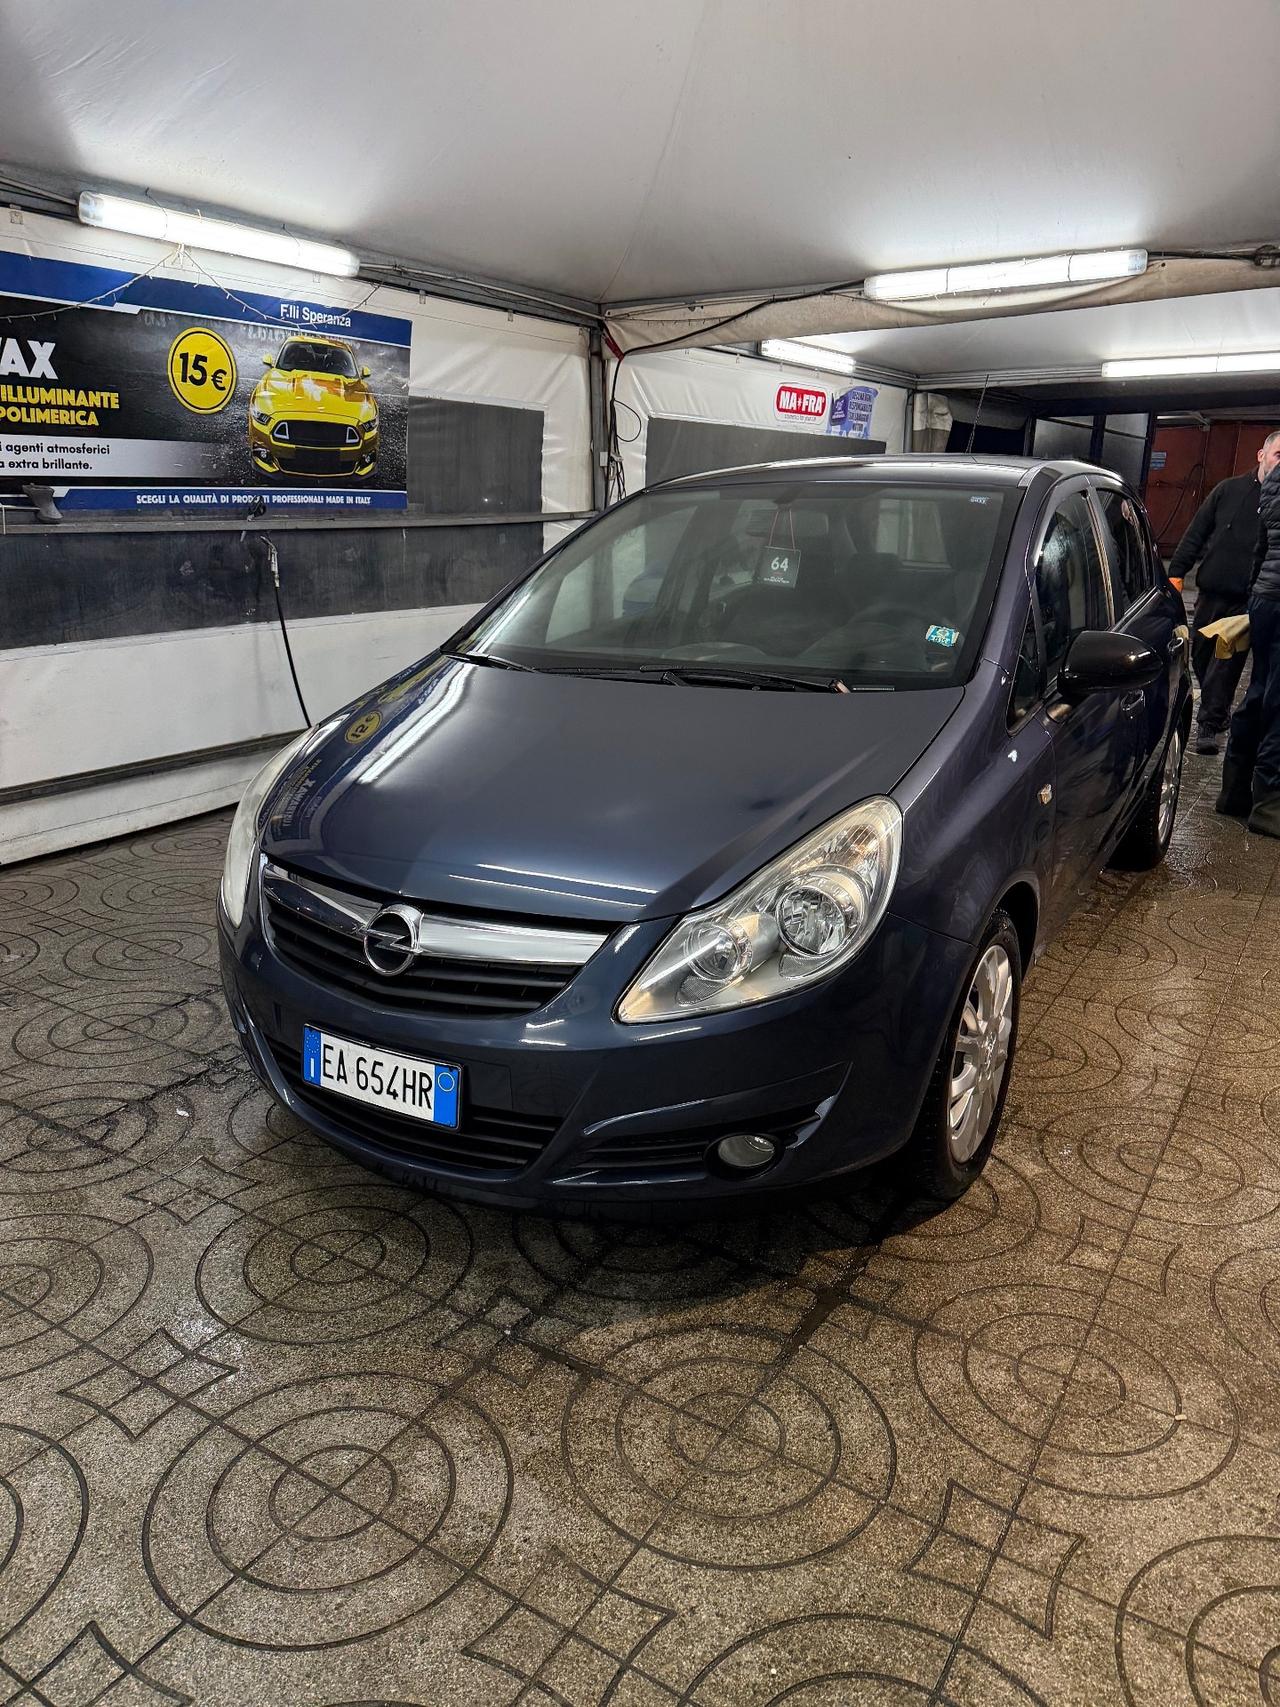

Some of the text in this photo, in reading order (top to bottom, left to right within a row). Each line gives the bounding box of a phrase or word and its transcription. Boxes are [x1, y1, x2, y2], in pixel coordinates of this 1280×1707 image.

[281, 304, 351, 327] F.lli Speranza
[0, 337, 58, 380] AX
[0, 385, 120, 409] ILLUMINANTE
[0, 406, 99, 426] POLIMERICA
[5, 443, 43, 455] agenti
[47, 443, 110, 455] atmosferici
[8, 459, 39, 469] extra
[42, 458, 93, 470] brillante.
[136, 494, 166, 504] SCEGLI
[169, 495, 180, 504] LA
[183, 493, 218, 504] QUALITÀ
[220, 495, 229, 504] DI
[272, 495, 324, 504] PROFESSIONALI
[326, 496, 344, 504] MADE
[346, 496, 354, 504] IN
[355, 496, 371, 504] ITALY
[771, 556, 789, 571] 64
[323, 1043, 433, 1109] EA 654HR
